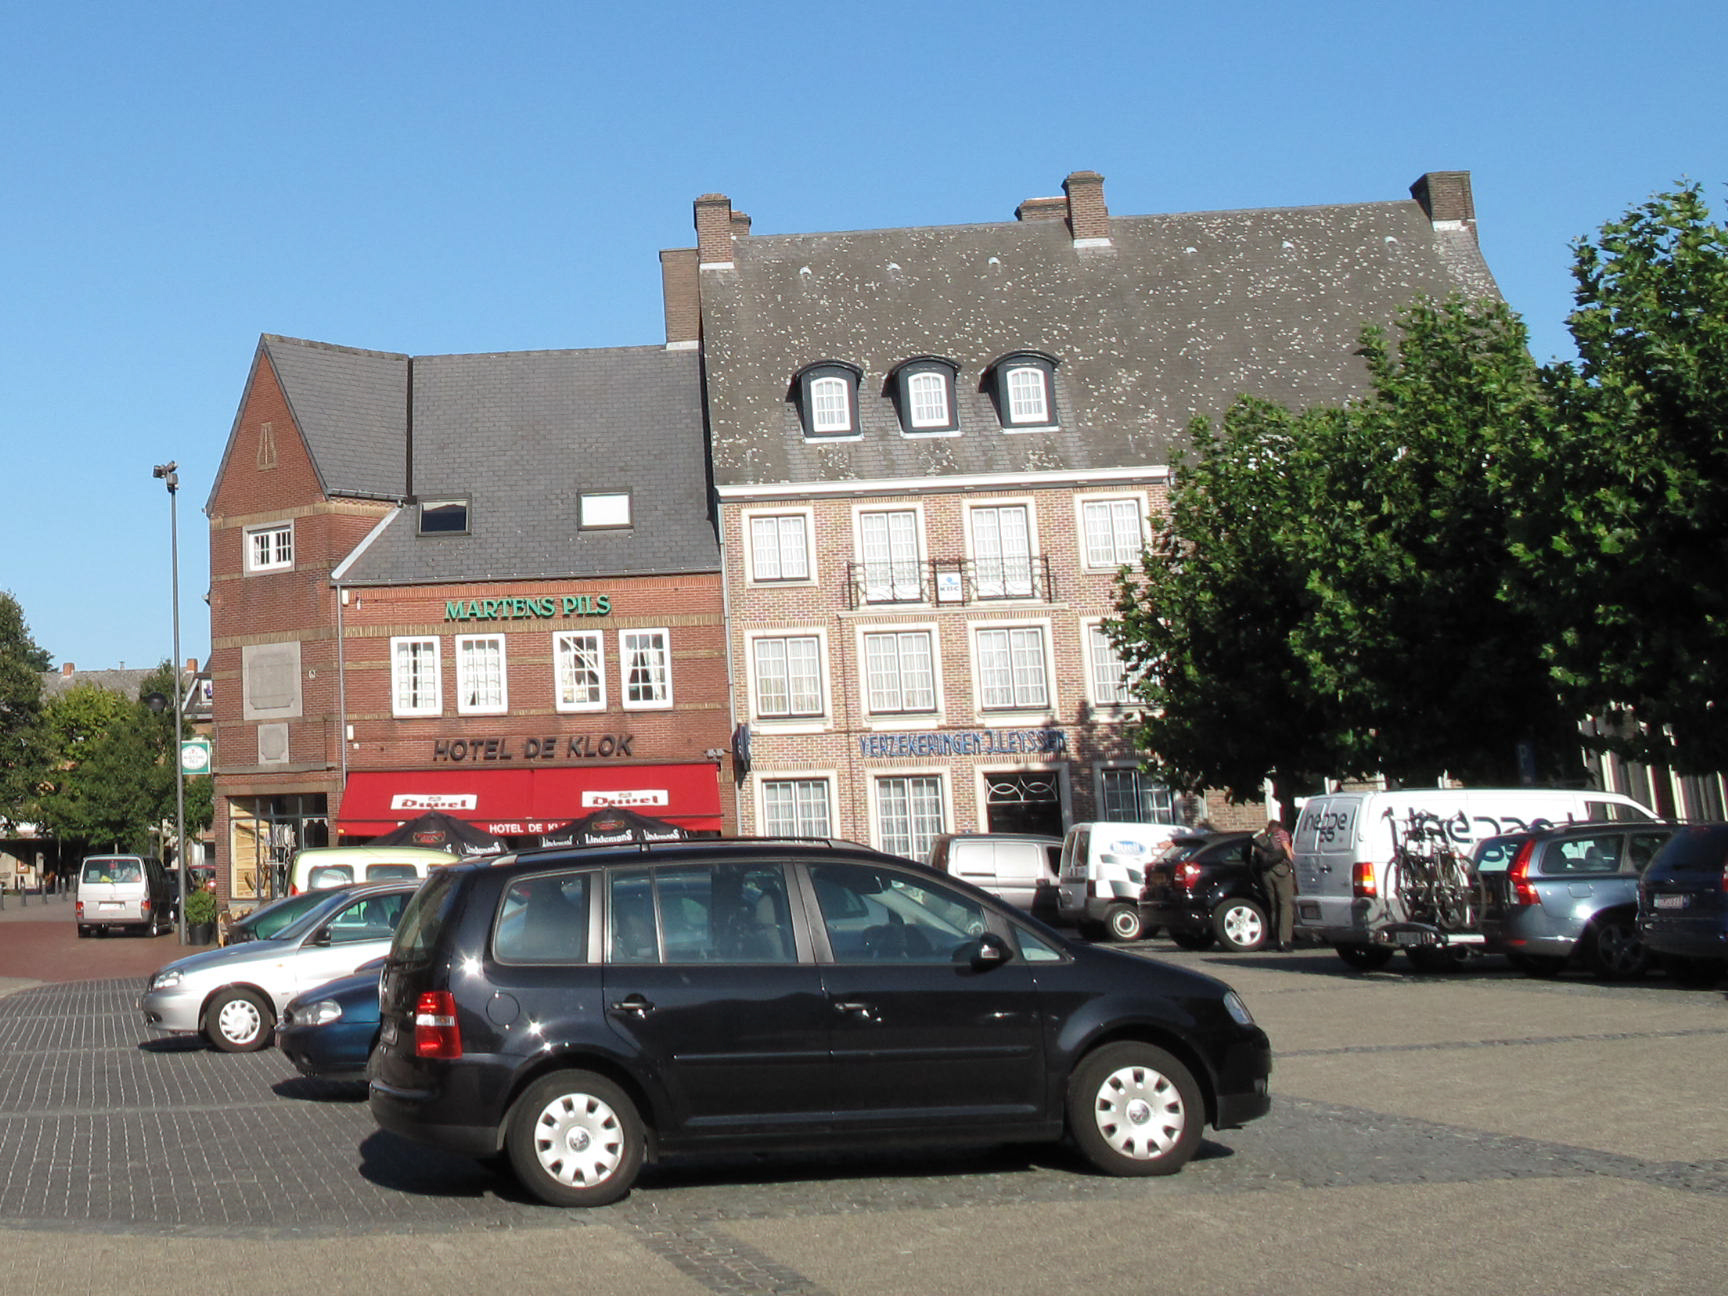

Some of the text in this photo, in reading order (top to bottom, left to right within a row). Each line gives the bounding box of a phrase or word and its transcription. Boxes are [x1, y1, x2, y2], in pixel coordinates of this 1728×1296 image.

[445, 595, 612, 620] MARTENS PILS
[433, 733, 634, 761] HOTEL DE KLOK
[859, 732, 981, 757] VERZEKERINGEN
[489, 824, 524, 834] HOTEL
[528, 823, 543, 833] DE
